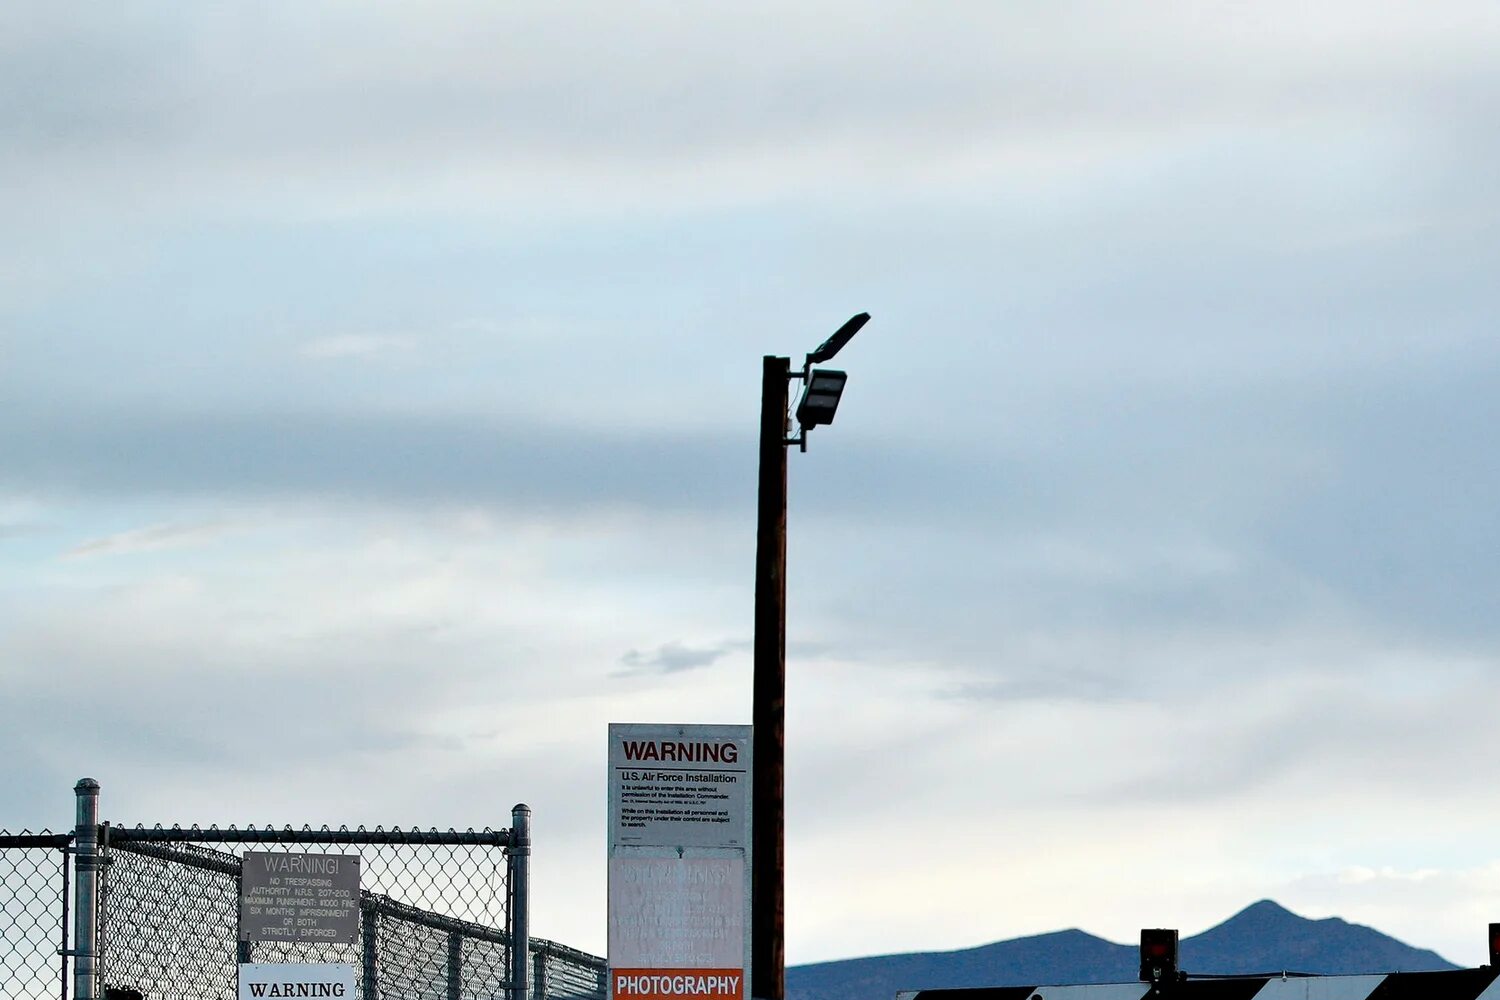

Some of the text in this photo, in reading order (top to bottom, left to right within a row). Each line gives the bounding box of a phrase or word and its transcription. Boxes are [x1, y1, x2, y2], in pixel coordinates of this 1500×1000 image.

[622, 741, 738, 763] WARNING
[622, 771, 737, 784] U.S. Air Force Installation
[264, 857, 339, 874] WARNING!
[269, 878, 332, 887] NO TRESPASSING
[250, 887, 291, 896] AUTHORITY
[318, 889, 350, 898] 207-200
[244, 896, 273, 905] MAXIMUM
[276, 897, 317, 906] PUNISHMENT:
[341, 899, 355, 908] FINE
[250, 906, 349, 917] SIX MONTHS IMPRISONMENT
[283, 918, 317, 927] OR BOTH
[261, 927, 337, 937] STRICTLY ENFORCED
[249, 983, 345, 998] WARNING
[617, 976, 739, 995] PHOTOGRAPHY
